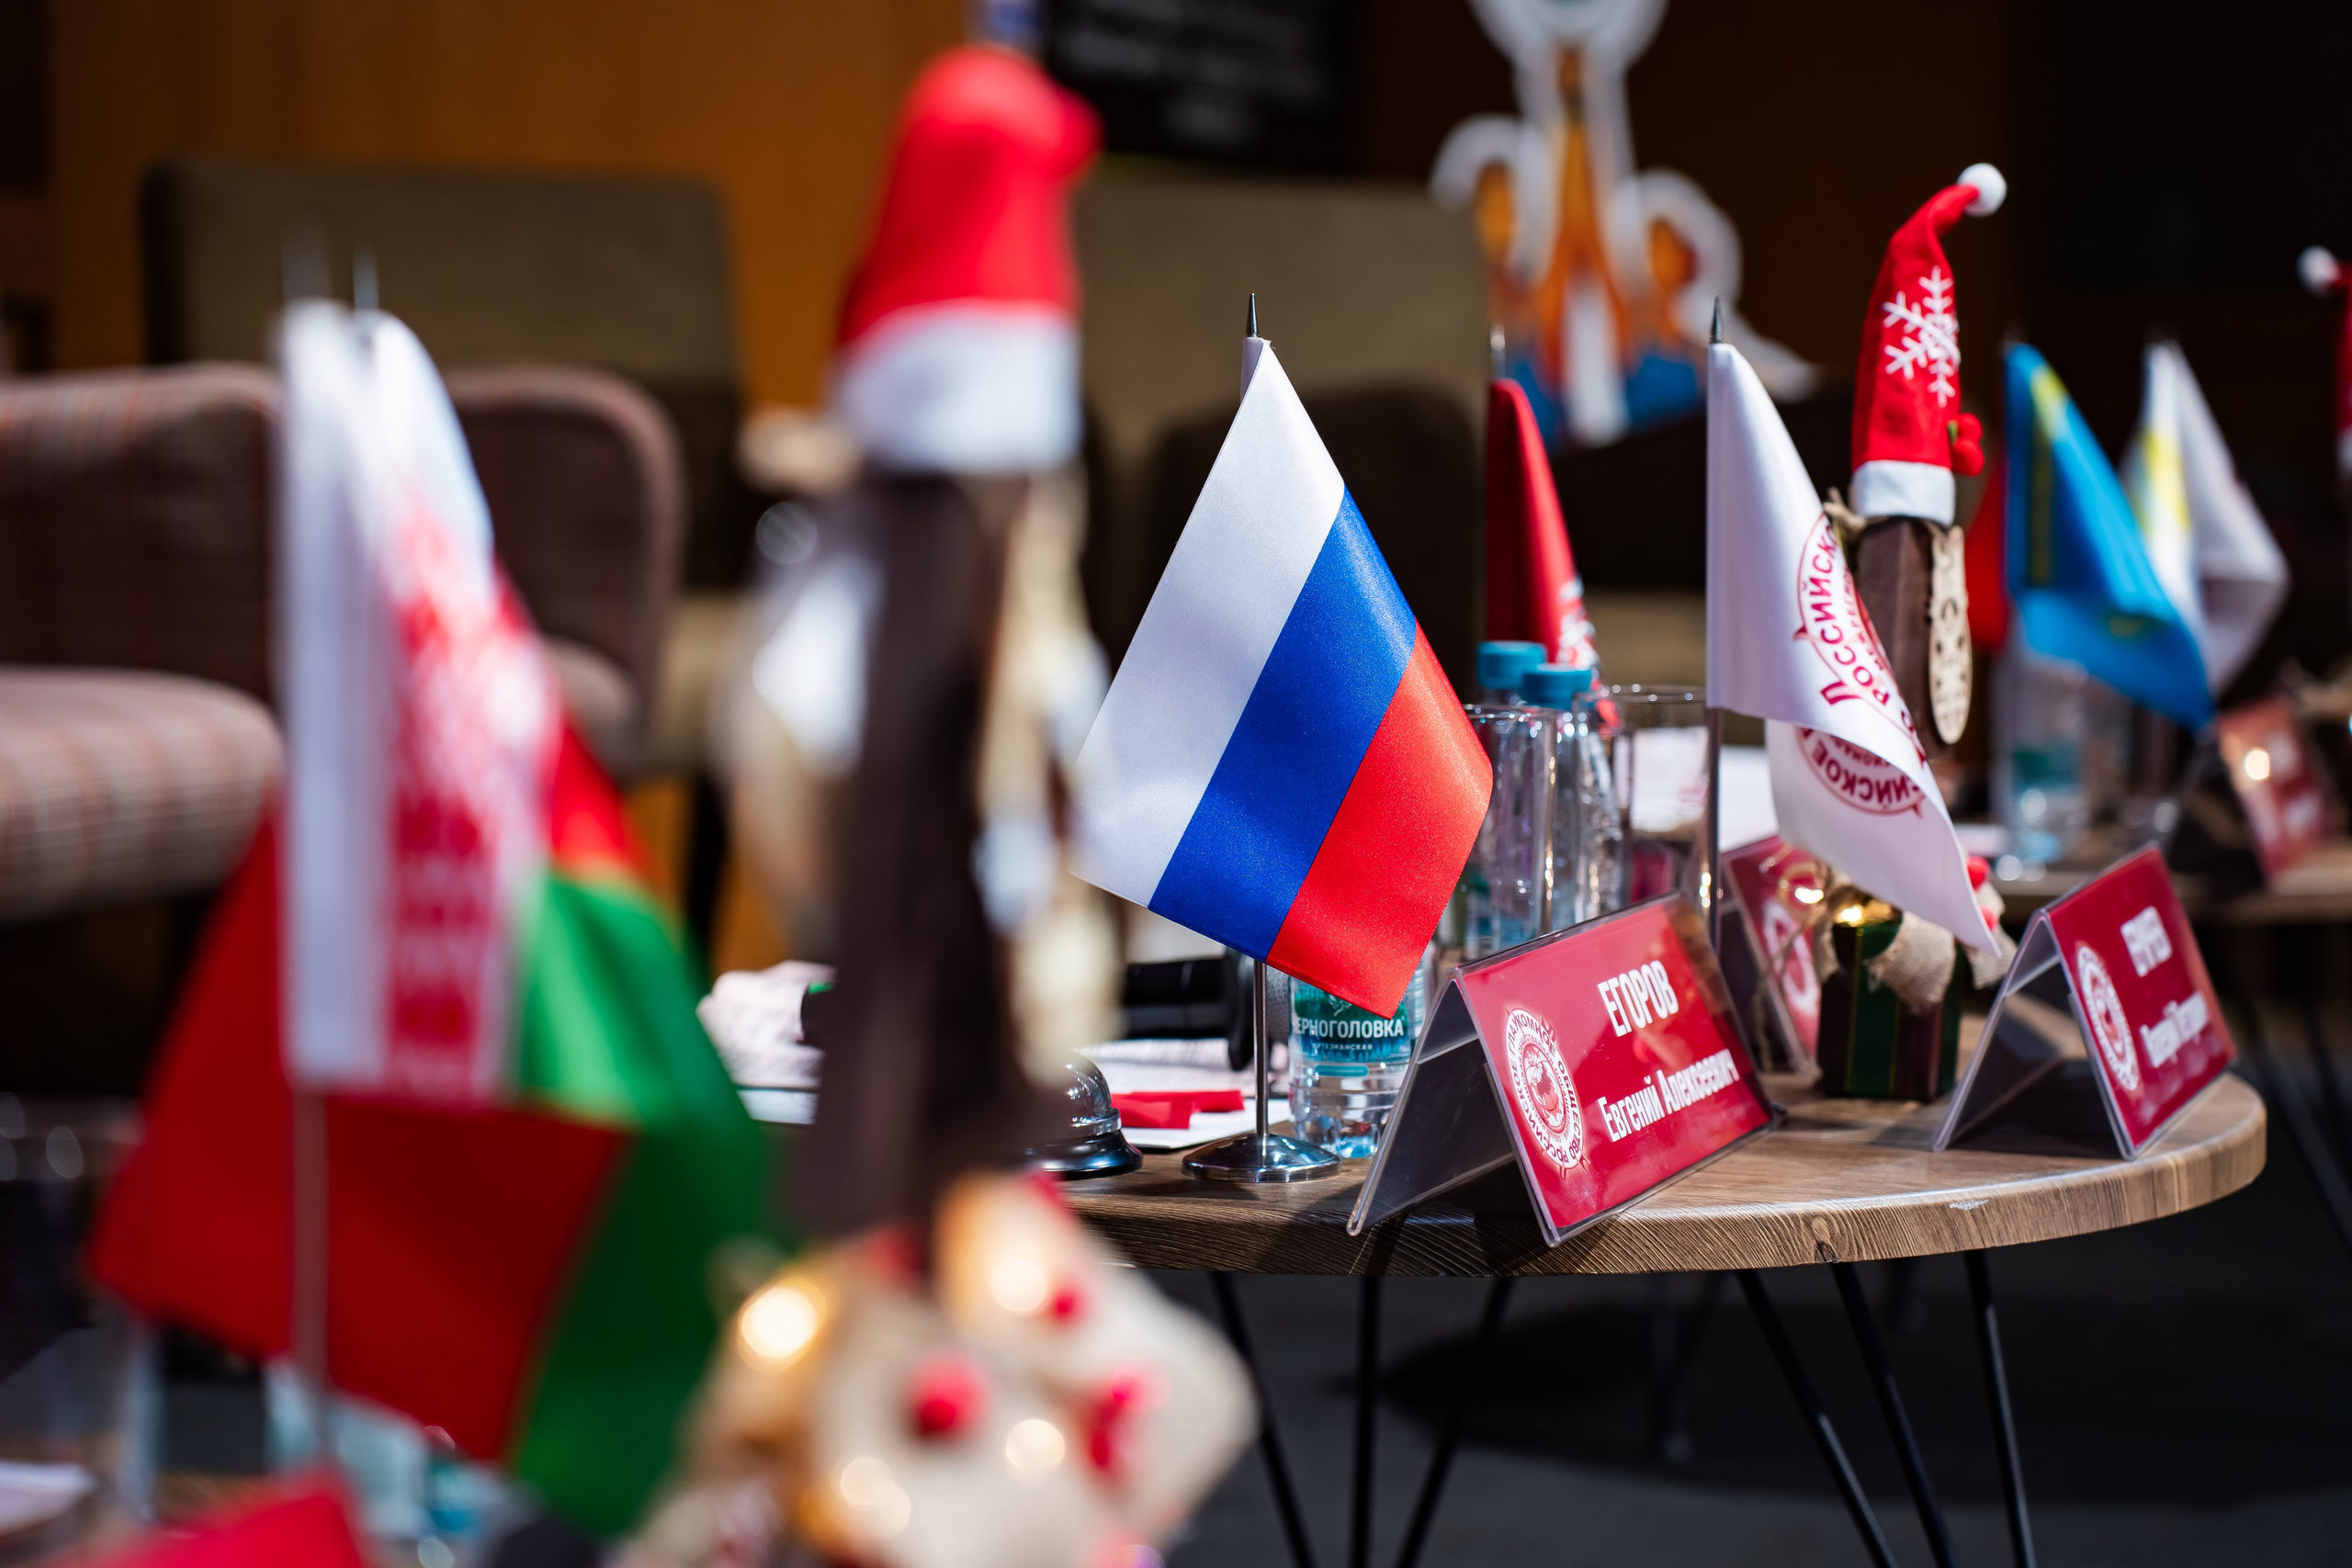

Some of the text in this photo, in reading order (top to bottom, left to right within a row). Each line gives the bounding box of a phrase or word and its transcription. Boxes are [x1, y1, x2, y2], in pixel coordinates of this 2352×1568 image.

[1295, 1017, 1404, 1038] ЕРНОГОЛОВКА
[1598, 960, 1679, 1037] ЕГОРОВ
[1508, 1013, 1581, 1163] РОССИЙСКОЕ ГЛАУКОМНОЕ ОБЩЕСТВО
[1597, 1075, 1665, 1142] Евгений
